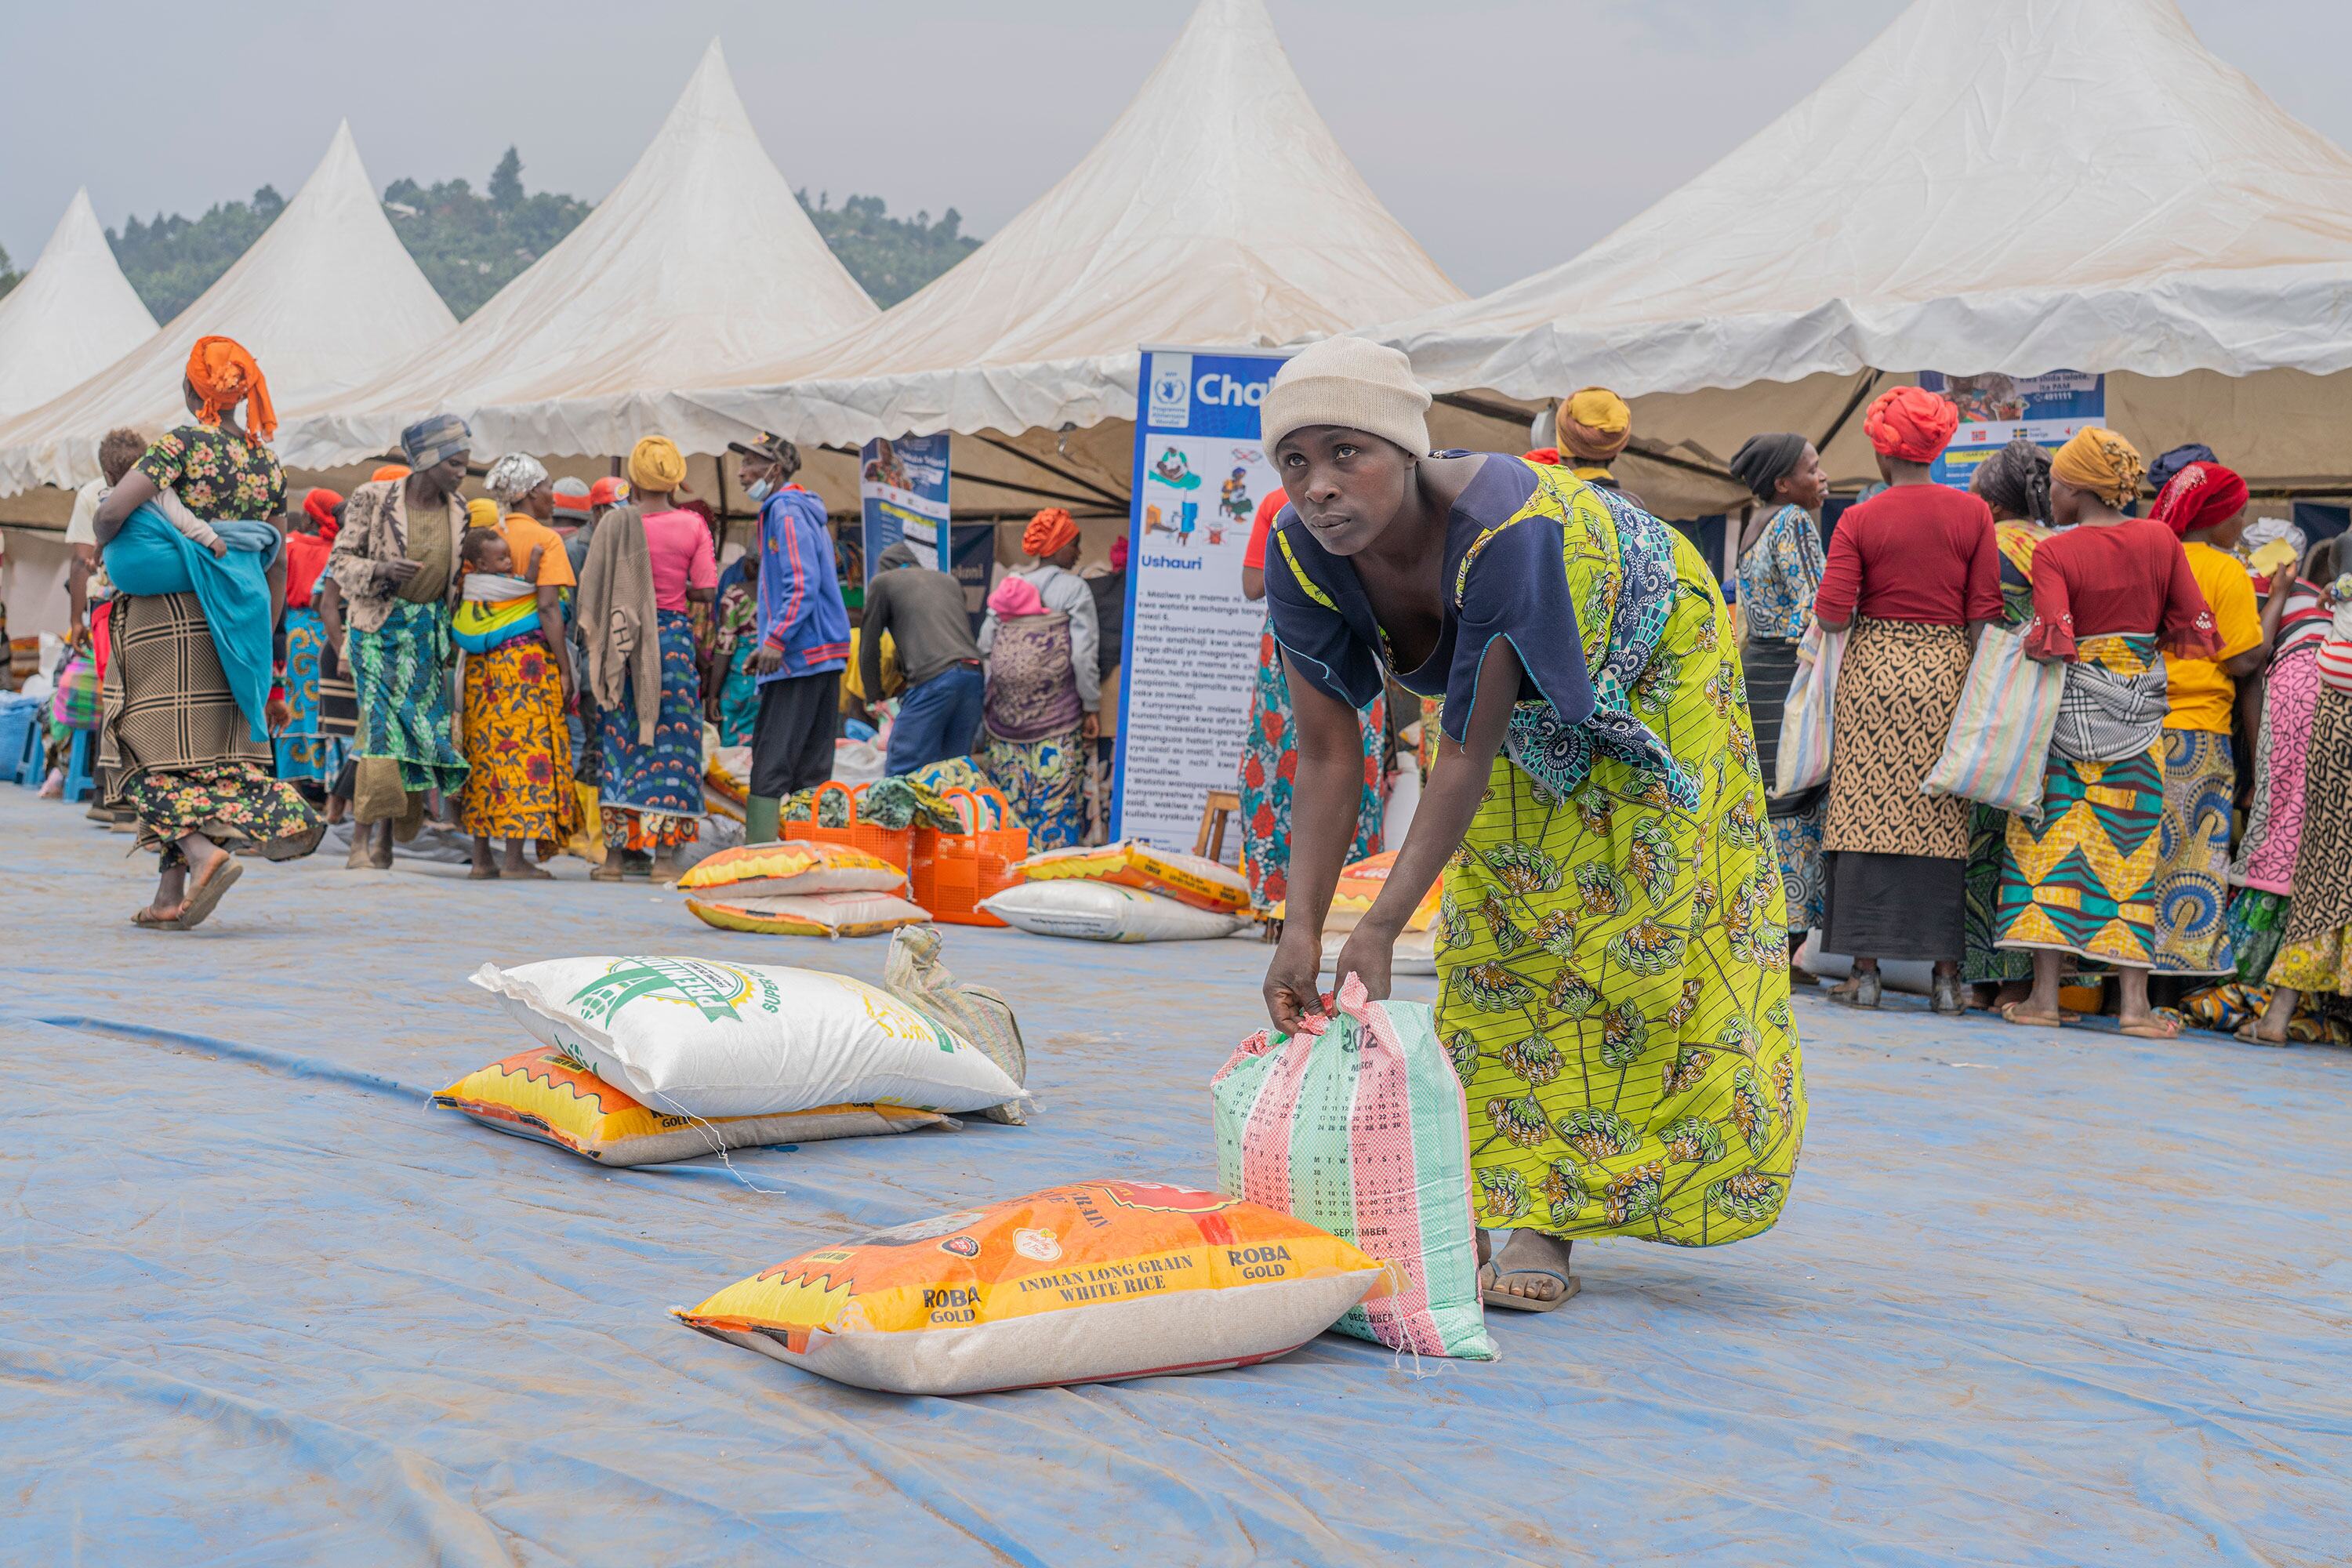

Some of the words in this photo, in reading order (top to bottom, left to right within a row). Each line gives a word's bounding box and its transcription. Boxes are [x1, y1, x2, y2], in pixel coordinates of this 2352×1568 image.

[1142, 555, 1202, 571] Ushauri
[761, 977, 782, 1014] SUPER
[662, 1115, 690, 1128] GOLD
[1227, 1245, 1292, 1268] ROBA
[1019, 1272, 1084, 1293] INDIAN
[1088, 1263, 1134, 1282] LONG
[1138, 1254, 1194, 1275] GRAIN
[1243, 1262, 1286, 1279] GOLD
[923, 1286, 982, 1309] ROBA
[1060, 1283, 1120, 1302] WHITE
[1124, 1275, 1167, 1292] RICE
[930, 1308, 976, 1323] GOLD
[1348, 1313, 1393, 1323] DECEMBER
